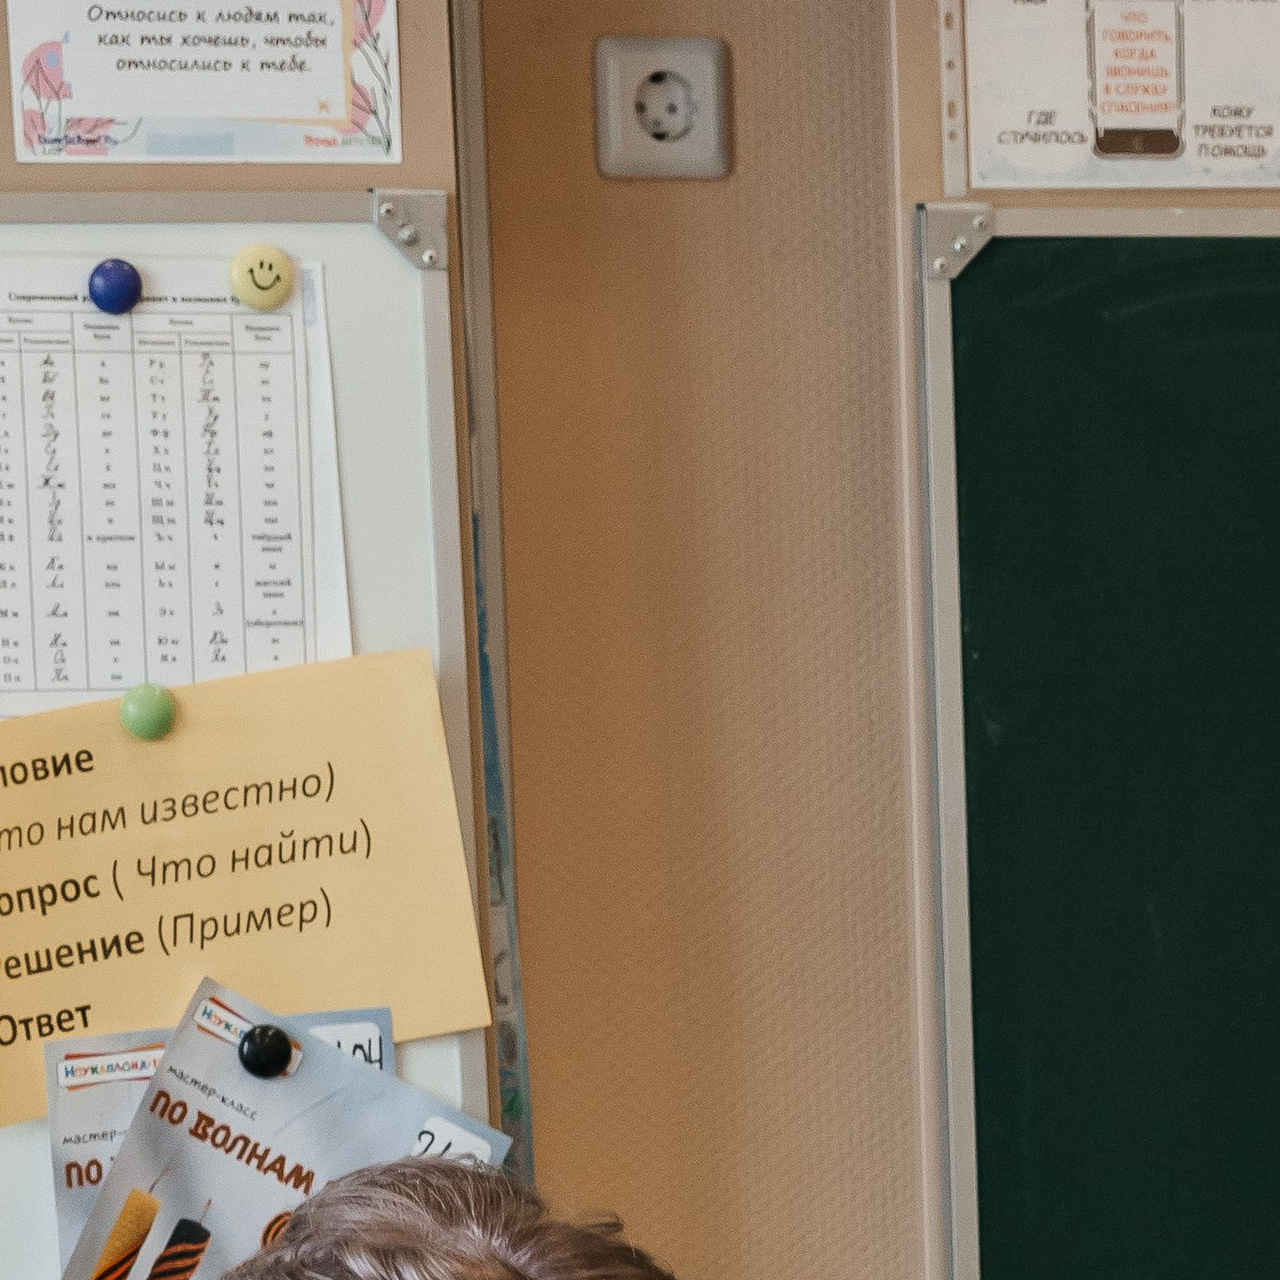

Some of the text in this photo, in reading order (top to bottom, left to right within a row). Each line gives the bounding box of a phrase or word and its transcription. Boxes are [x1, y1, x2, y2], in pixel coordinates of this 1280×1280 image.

[87, 4, 188, 22] Относись
[195, 10, 207, 22] к
[215, 4, 279, 23] людям
[98, 33, 131, 46] как
[140, 33, 173, 46] ты
[263, 31, 328, 48] чтобы
[115, 58, 232, 72] относились
[240, 60, 252, 72] к
[57, 804, 127, 841] нам
[140, 761, 336, 825] известно)
[136, 849, 217, 888] Что
[230, 818, 373, 875] найти)
[4, 887, 333, 980] ешение (Пример)
[0, 1004, 92, 1046] Ответ
[168, 1064, 258, 1121] мастер-класс
[188, 1109, 315, 1196] ВОЛНАМ
